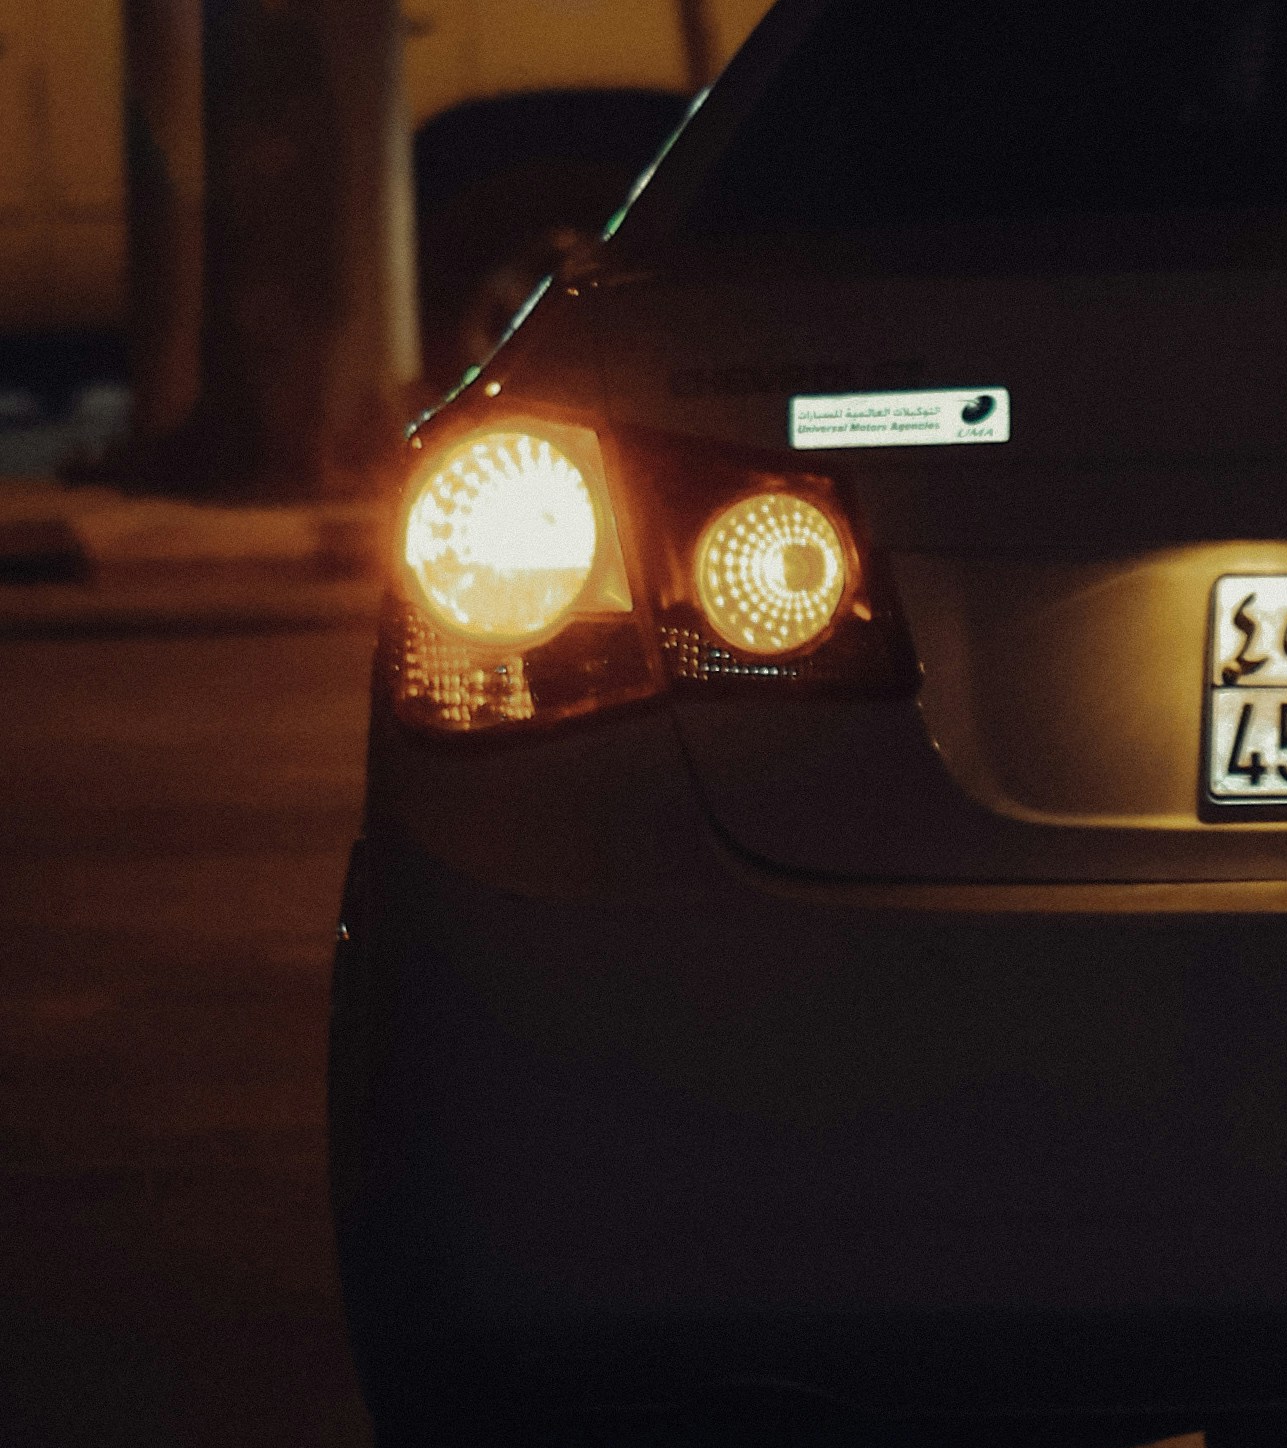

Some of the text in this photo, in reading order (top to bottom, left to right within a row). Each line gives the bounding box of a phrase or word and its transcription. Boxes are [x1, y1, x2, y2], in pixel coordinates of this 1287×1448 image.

[797, 422, 941, 434] Universal Motors Agencies
